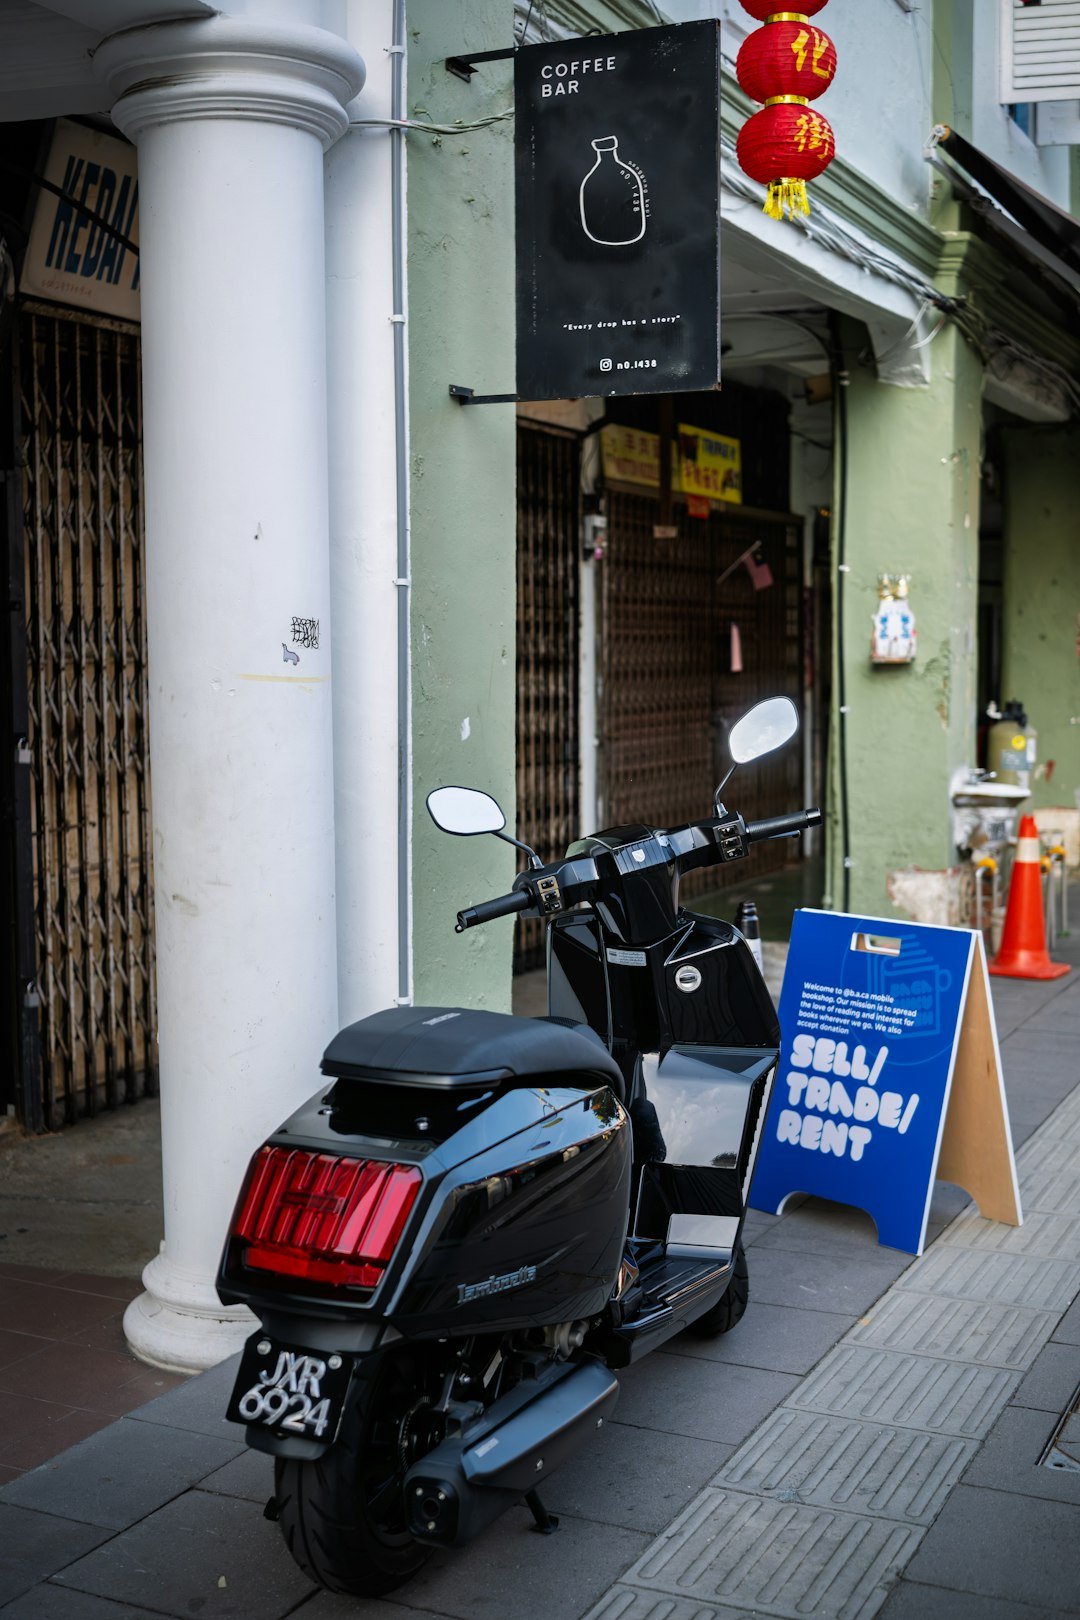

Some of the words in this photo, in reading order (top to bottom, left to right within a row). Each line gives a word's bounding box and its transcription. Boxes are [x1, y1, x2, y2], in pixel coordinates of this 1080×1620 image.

[791, 27, 833, 80] 化
[541, 56, 616, 79] COFFEE
[541, 80, 579, 98] BAR
[802, 991, 835, 1004] bookshop.
[836, 997, 849, 1005] Our
[850, 999, 876, 1010] mission
[877, 1003, 883, 1011] is
[884, 1004, 892, 1012] to
[892, 1008, 917, 1018] spread
[804, 982, 834, 994] Welcome
[844, 988, 869, 1000] @b.a.ca
[870, 993, 894, 1003] mobile
[796, 1020, 819, 1030] accept
[820, 1022, 849, 1034] donation
[798, 1009, 818, 1020] books
[819, 1013, 850, 1024] wherever
[851, 1018, 862, 1026] we
[862, 1021, 873, 1030] go.
[874, 1022, 886, 1032] We
[888, 1025, 902, 1034] also
[800, 1000, 811, 1008] the
[812, 1002, 826, 1012] love
[835, 1006, 860, 1018] reading
[862, 1011, 875, 1020] and
[876, 1012, 902, 1024] interest
[904, 1018, 914, 1027] for
[790, 1034, 889, 1086] SELL/
[786, 1071, 920, 1134] TRADE/
[776, 1108, 873, 1162] RENT
[259, 1351, 327, 1398] JXR
[239, 1383, 331, 1437] 6924
